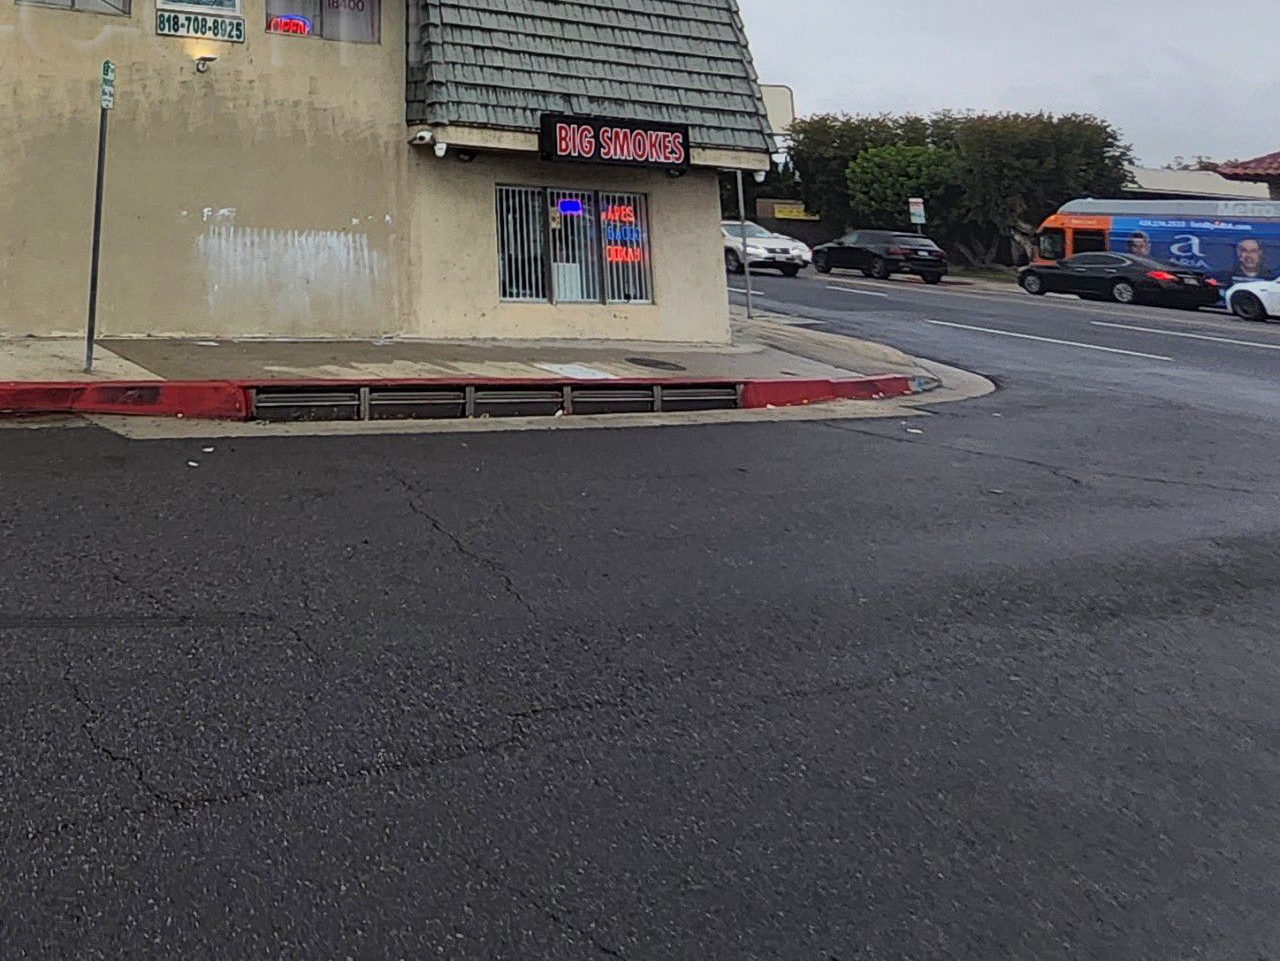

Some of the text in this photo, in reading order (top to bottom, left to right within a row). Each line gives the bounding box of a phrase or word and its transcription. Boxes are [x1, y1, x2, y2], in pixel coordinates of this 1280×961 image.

[158, 12, 244, 40] 818-708-8925
[555, 123, 685, 164] BIG SMOKES
[1216, 201, 1276, 217] Metro
